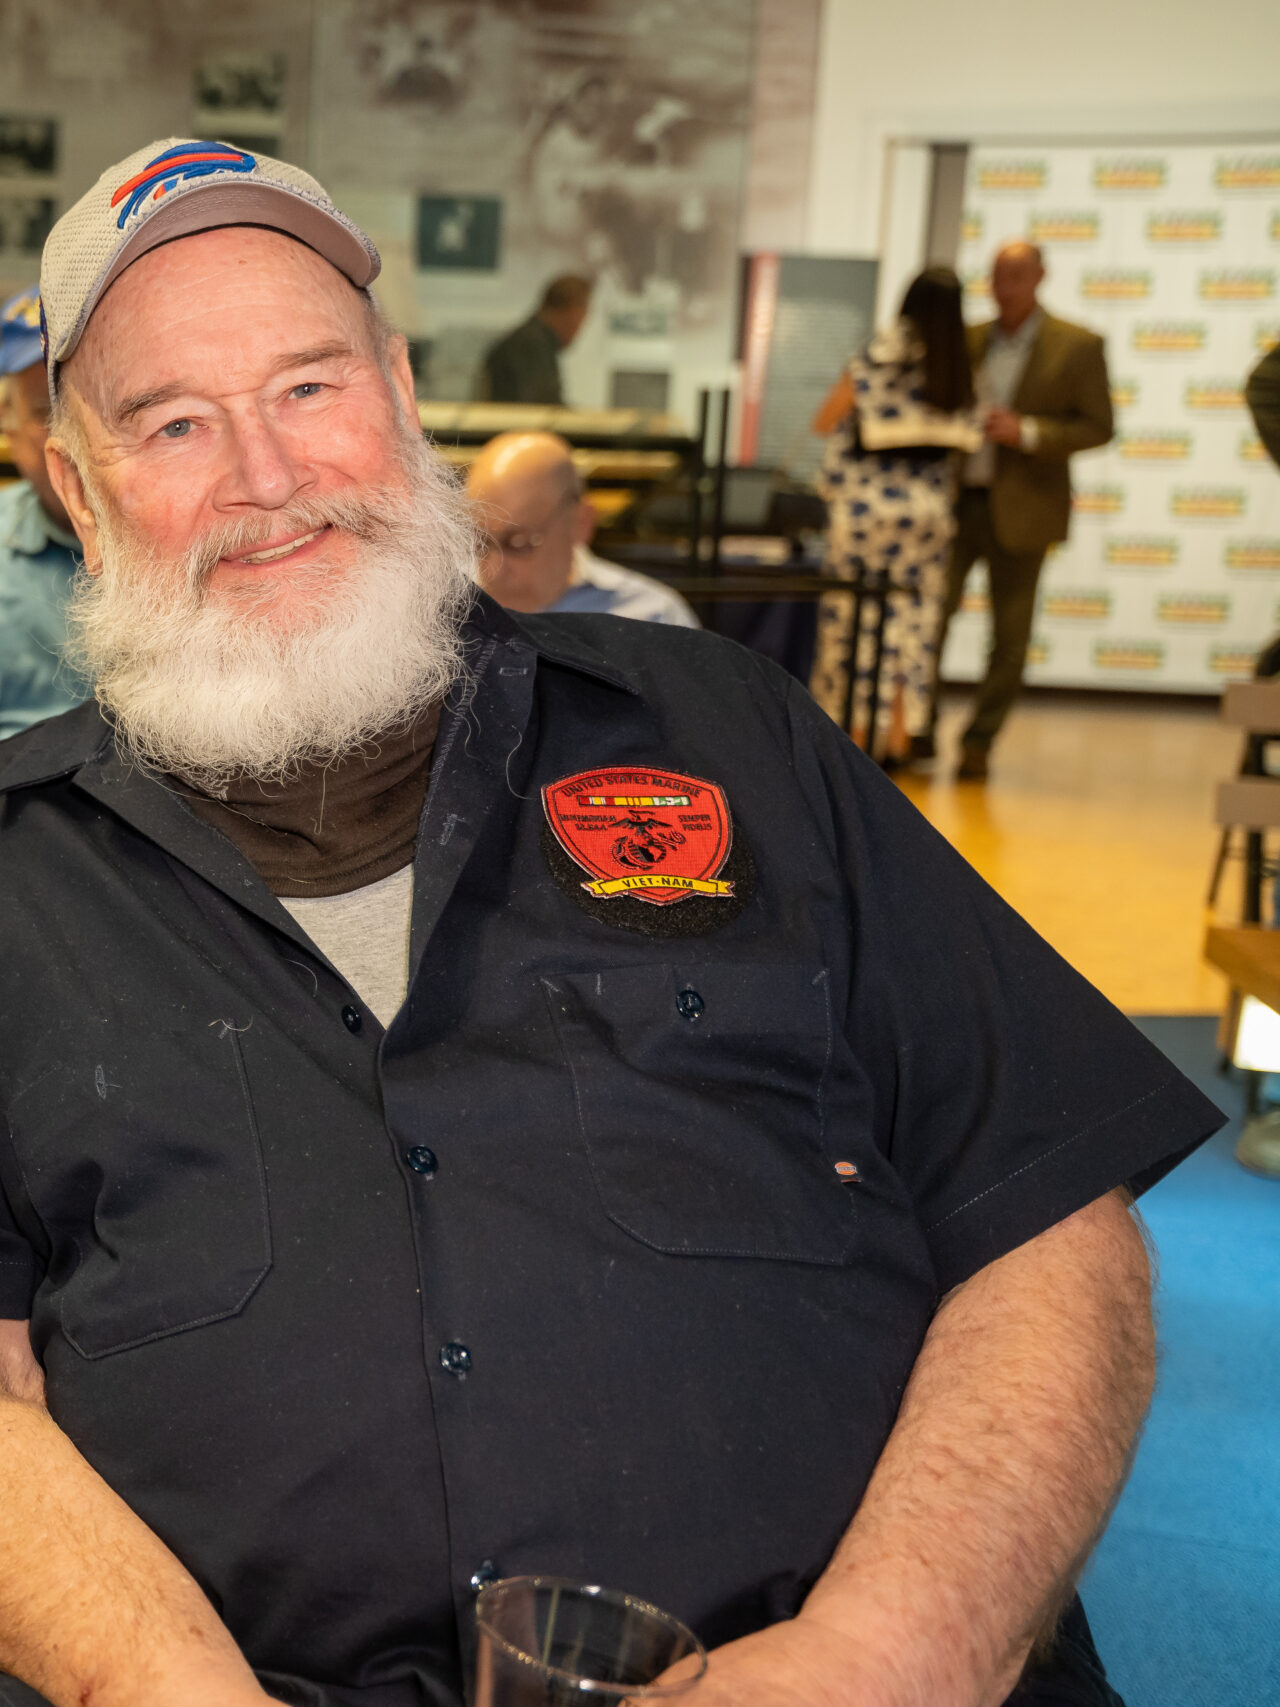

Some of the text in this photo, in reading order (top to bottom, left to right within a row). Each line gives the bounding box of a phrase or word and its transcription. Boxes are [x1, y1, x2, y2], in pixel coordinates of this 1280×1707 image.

[561, 775, 702, 798] UNITED STATES MARINE
[678, 814, 711, 822] SEMPER
[622, 877, 694, 889] VIET-NAM
